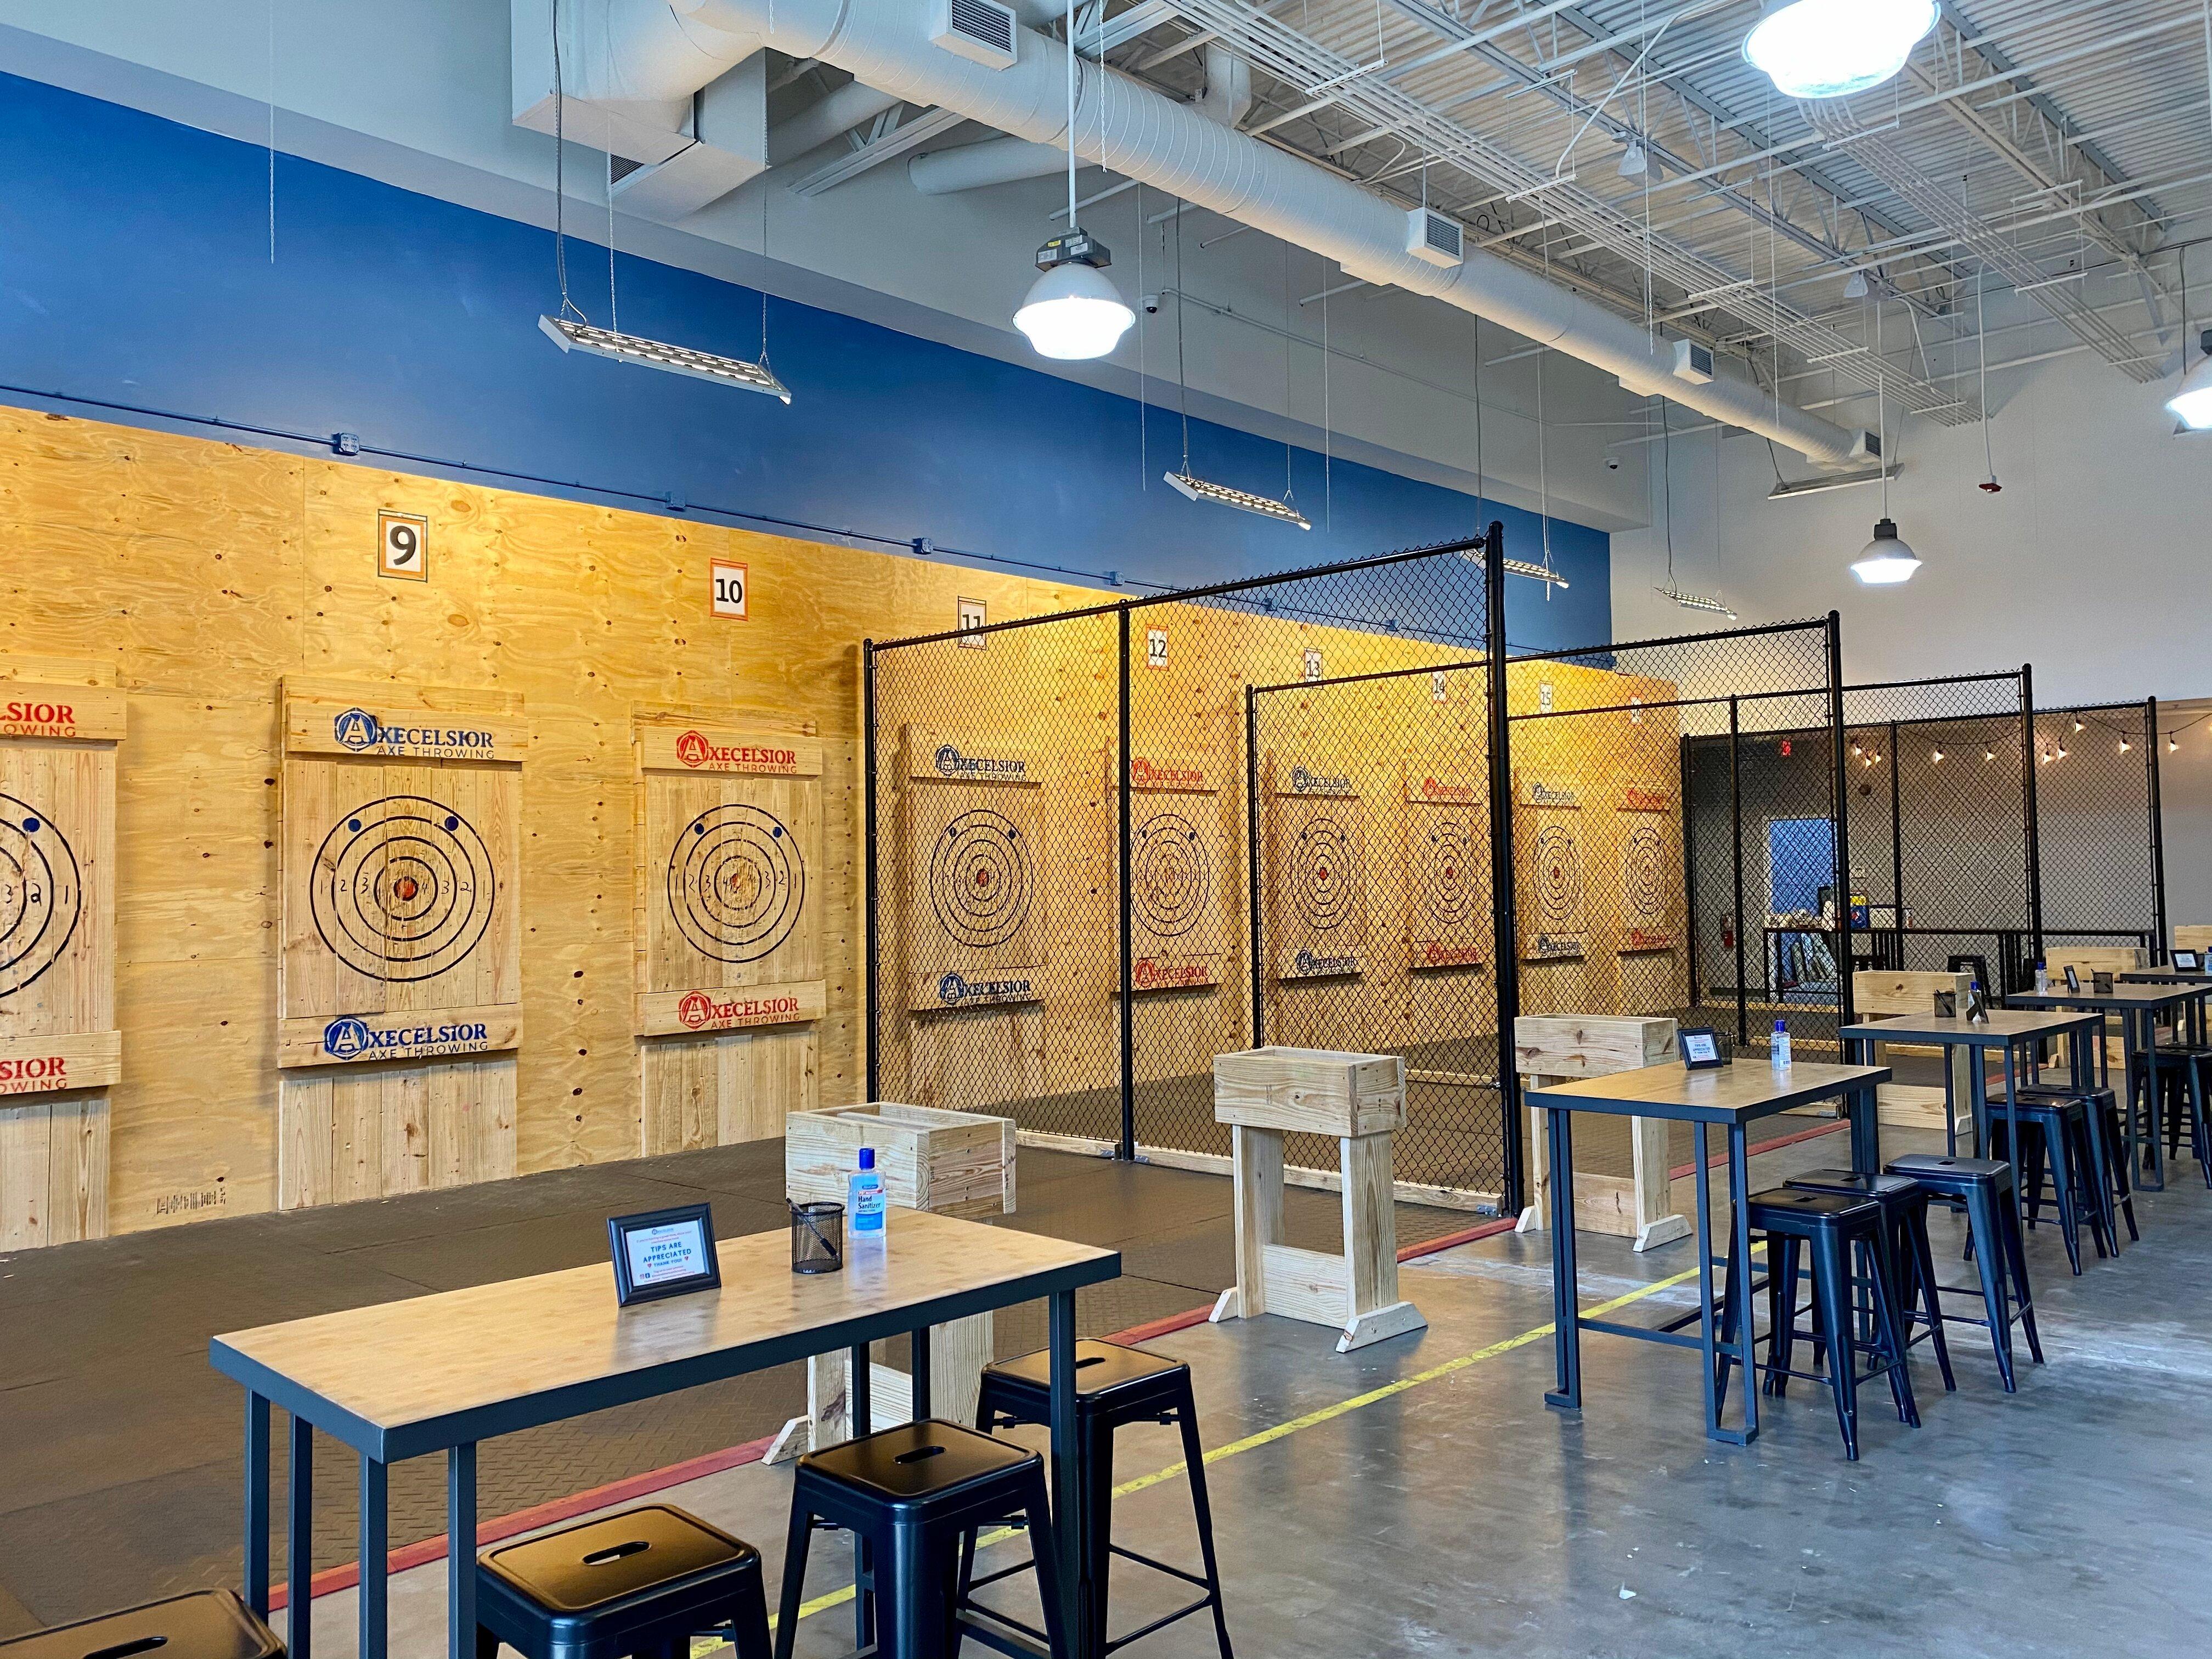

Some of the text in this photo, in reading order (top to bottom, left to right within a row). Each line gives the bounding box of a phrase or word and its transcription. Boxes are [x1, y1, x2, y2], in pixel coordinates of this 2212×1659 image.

[390, 526, 416, 565] 9
[715, 579, 742, 603] 10
[962, 614, 981, 634] 11
[1150, 639, 1167, 658] 12
[376, 746, 494, 759] AXE THROWING
[709, 762, 797, 774] AXE THROWING
[340, 879, 347, 892] 2
[361, 877, 369, 894] 3
[441, 880, 449, 894] 3
[712, 1013, 800, 1029] AXE THROWING
[369, 1041, 488, 1060] AXE THROWING
[643, 1249, 692, 1263] APPRECIATED
[651, 1242, 682, 1253] TIPS ARE
